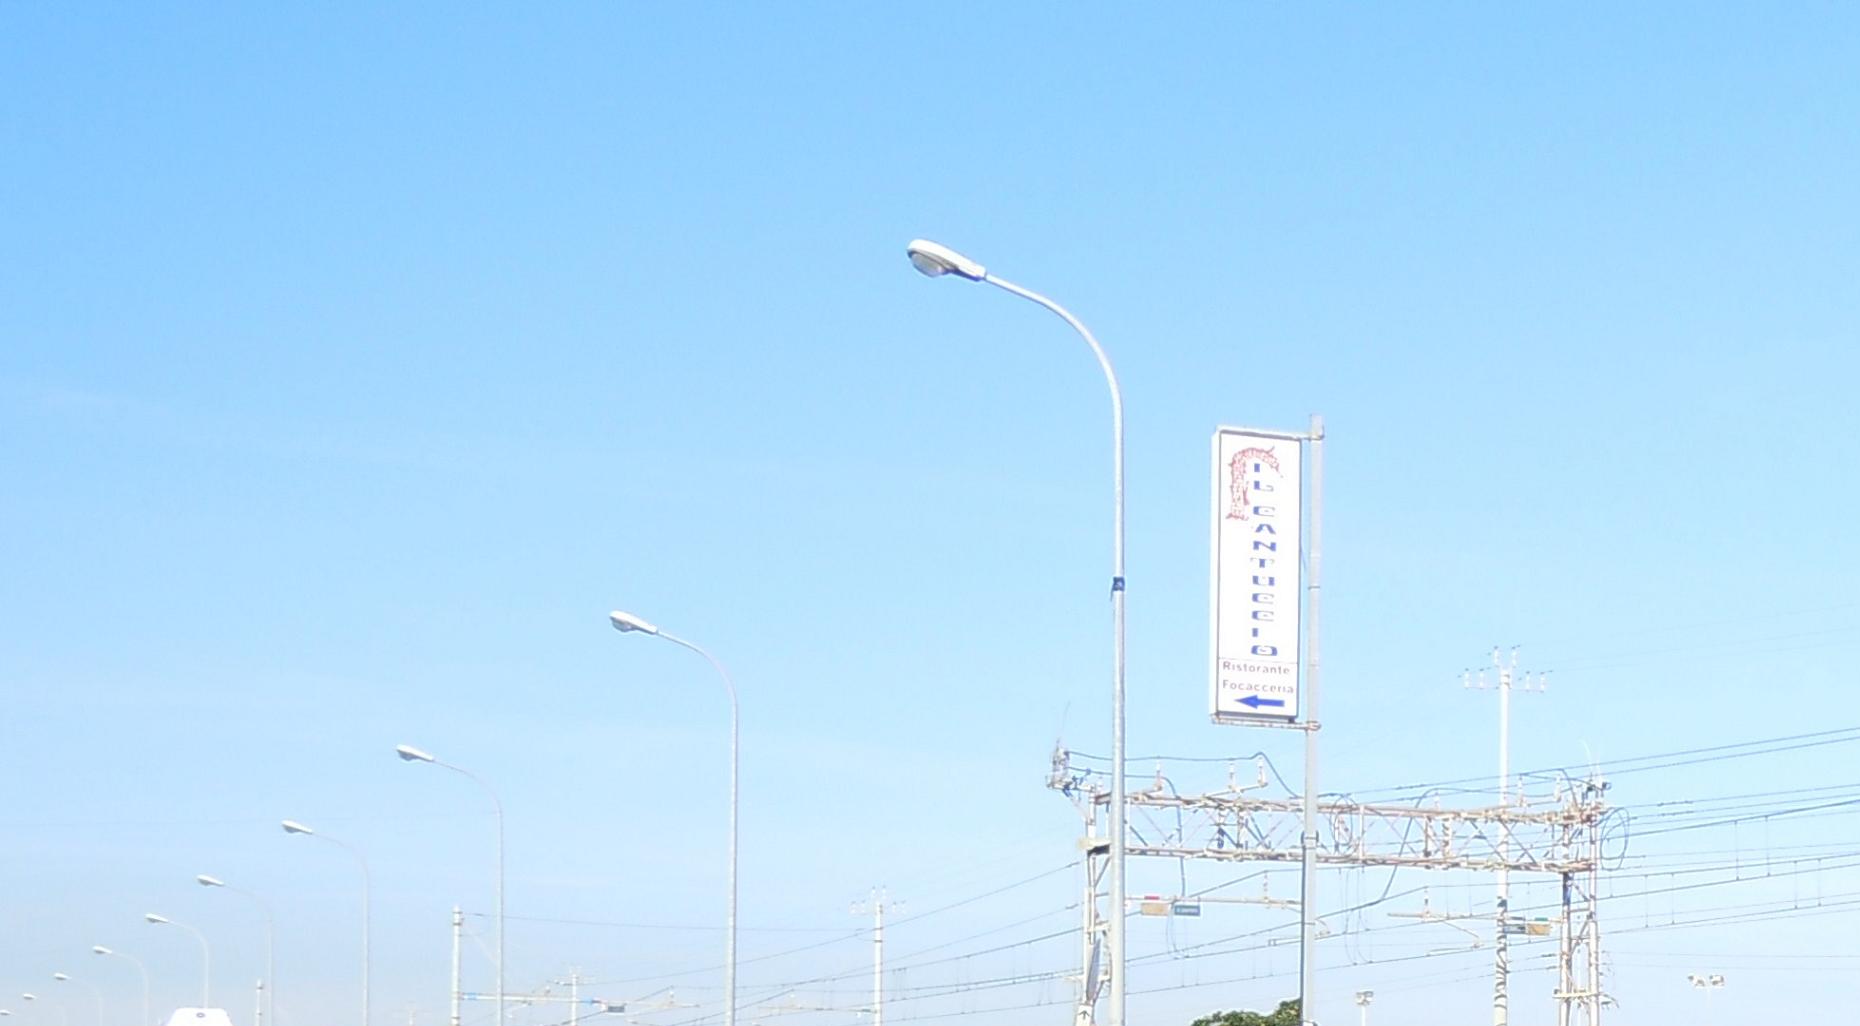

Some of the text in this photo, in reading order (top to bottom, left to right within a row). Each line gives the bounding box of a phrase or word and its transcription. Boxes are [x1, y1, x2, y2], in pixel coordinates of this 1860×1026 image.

[1250, 505, 1278, 657] CANTUCCIO
[1222, 661, 1290, 675] Ristorante
[1222, 679, 1294, 694] Focacceria
